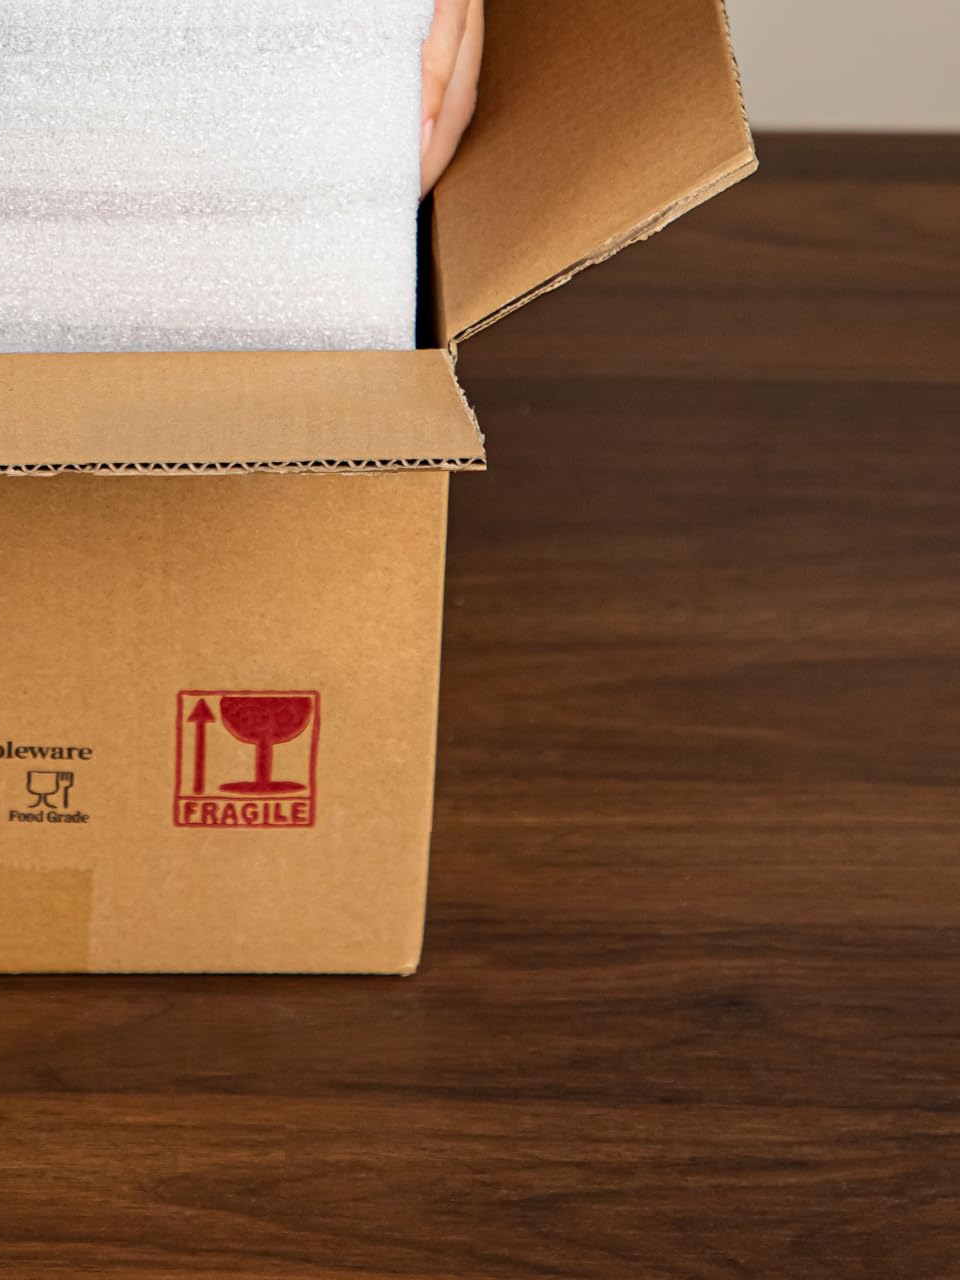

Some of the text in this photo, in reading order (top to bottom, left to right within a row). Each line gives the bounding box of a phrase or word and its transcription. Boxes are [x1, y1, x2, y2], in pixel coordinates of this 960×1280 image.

[8, 809, 90, 824] Food Grade
[183, 801, 308, 825] FRAGILE
